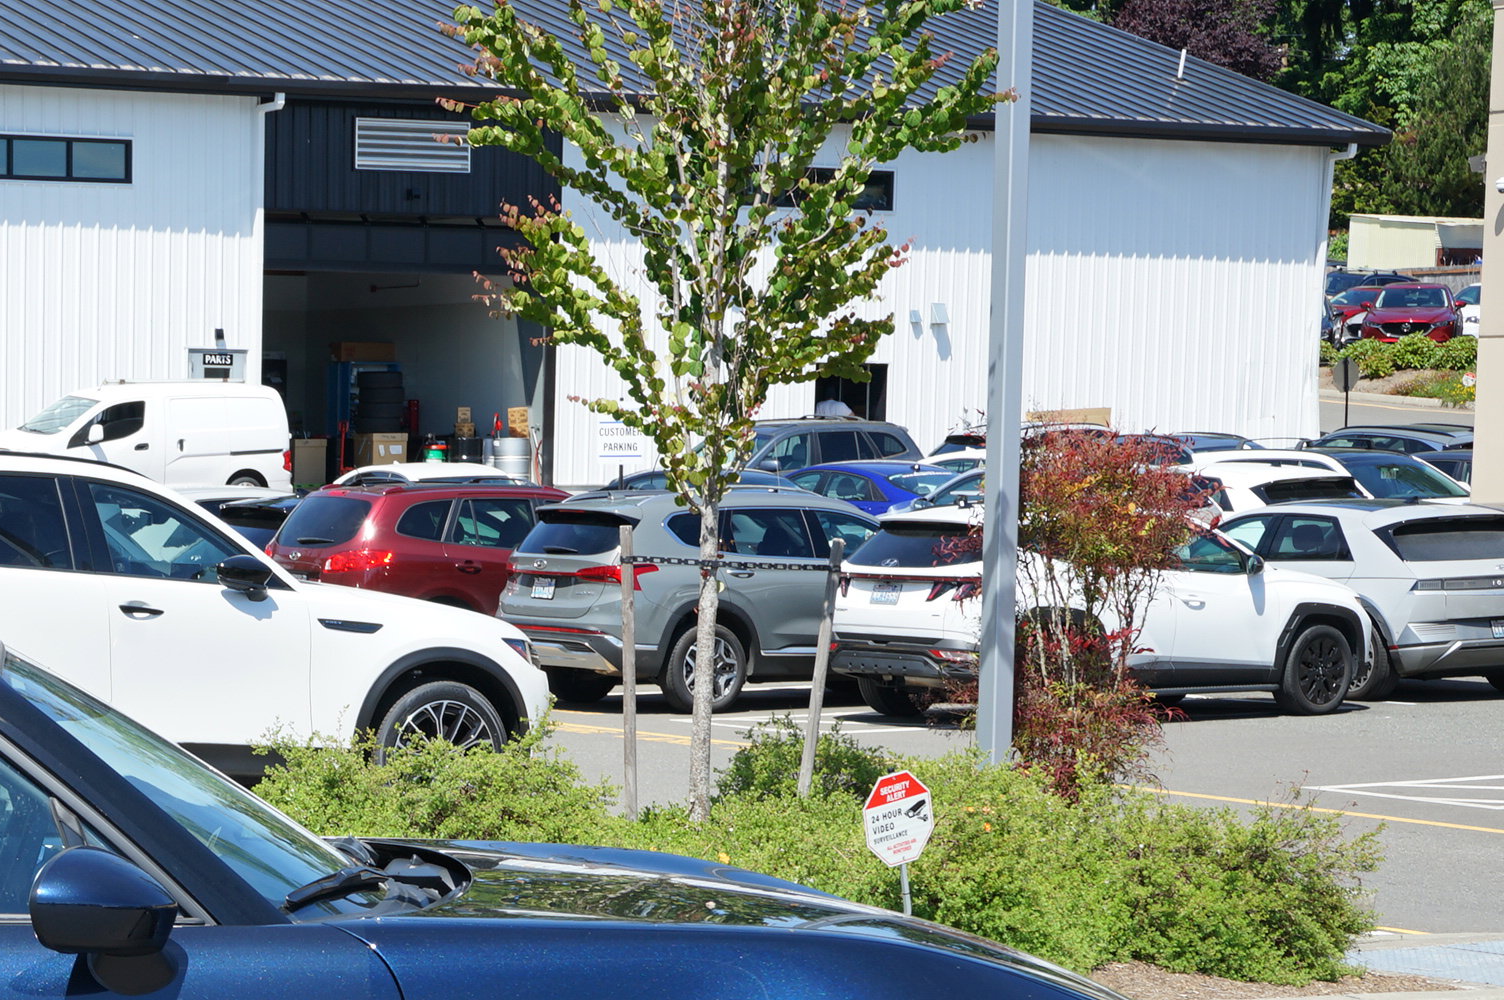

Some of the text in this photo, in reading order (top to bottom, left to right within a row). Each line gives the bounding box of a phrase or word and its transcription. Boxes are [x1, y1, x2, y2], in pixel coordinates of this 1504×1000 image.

[205, 354, 231, 364] PARTS
[603, 442, 638, 451] PARKING
[880, 780, 910, 796] SECURITY
[886, 790, 906, 802] ALERT
[871, 808, 903, 824] 24 HOUR
[872, 822, 895, 835] VIDEO
[873, 829, 908, 845] SURVEILLANCE
